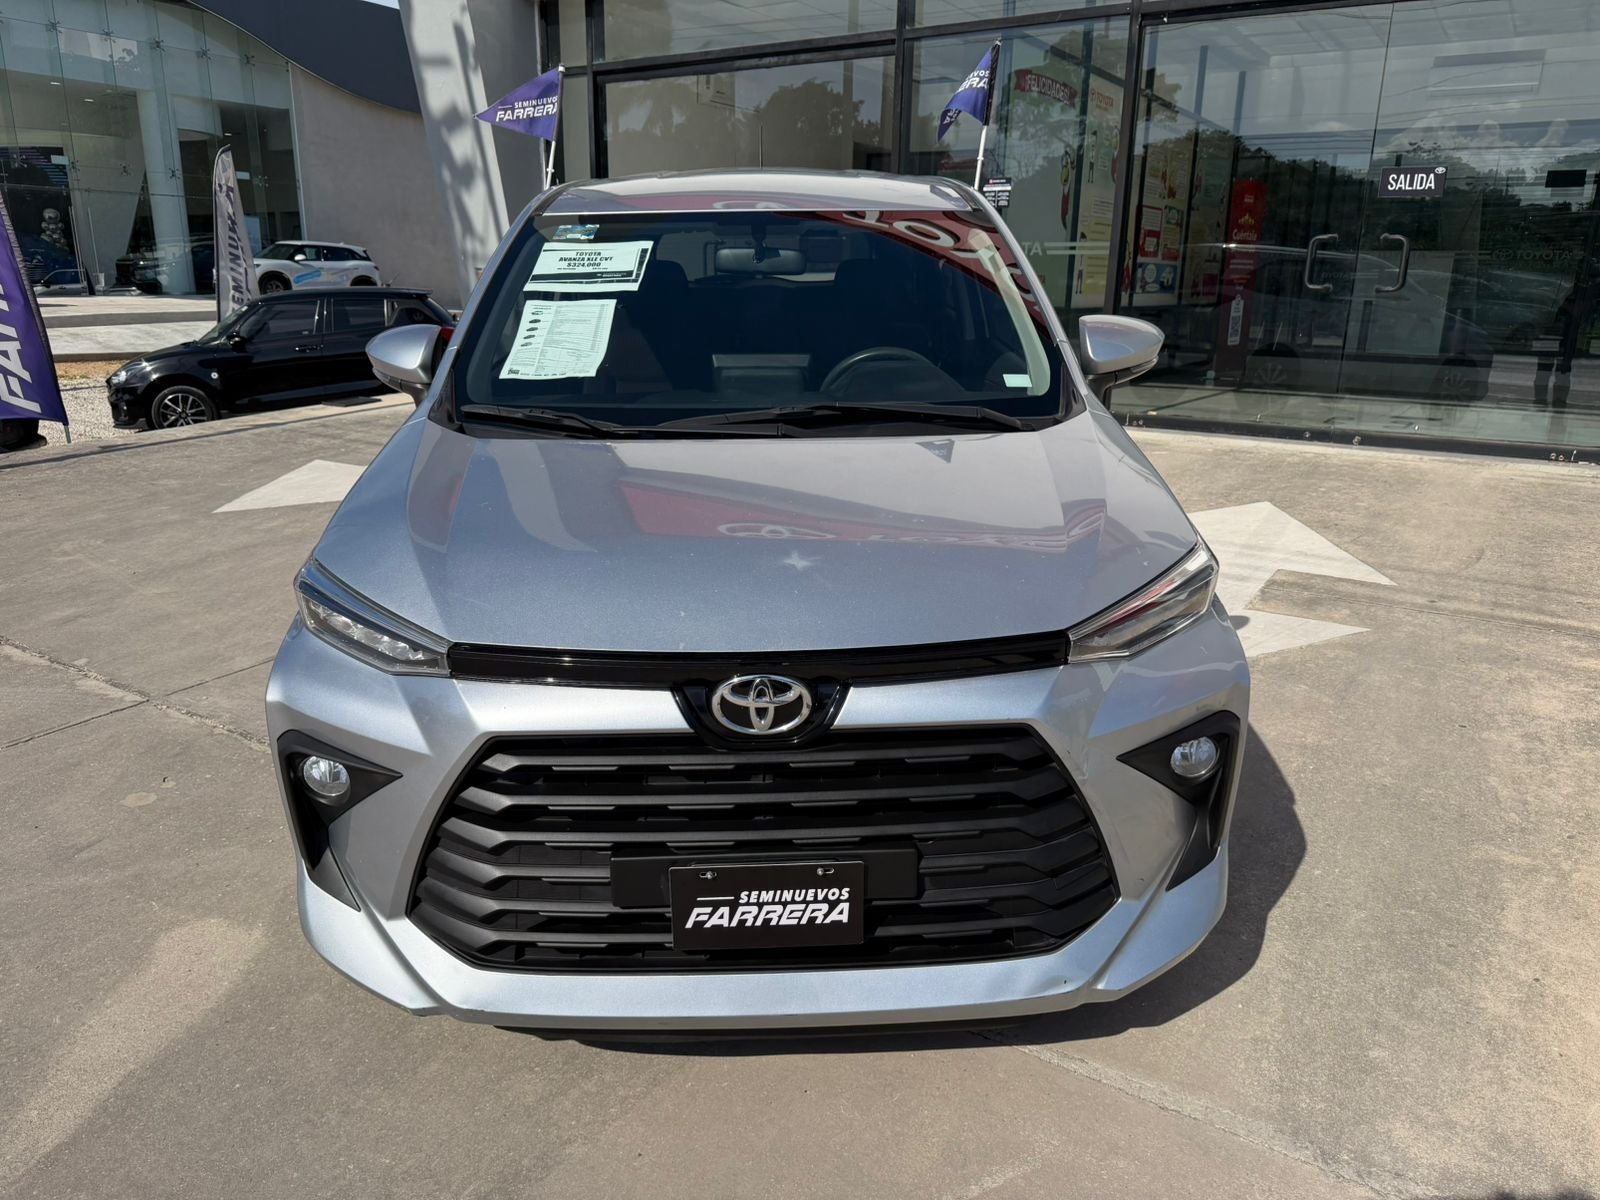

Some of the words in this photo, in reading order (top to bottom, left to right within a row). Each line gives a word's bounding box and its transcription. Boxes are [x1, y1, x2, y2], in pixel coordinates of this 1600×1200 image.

[514, 95, 558, 109] SEMINUEVO
[1387, 173, 1435, 191] SALIDA
[1517, 250, 1570, 260] TOYOTA
[738, 888, 850, 903] SEMINUEVOS
[685, 902, 850, 929] FARRERA
